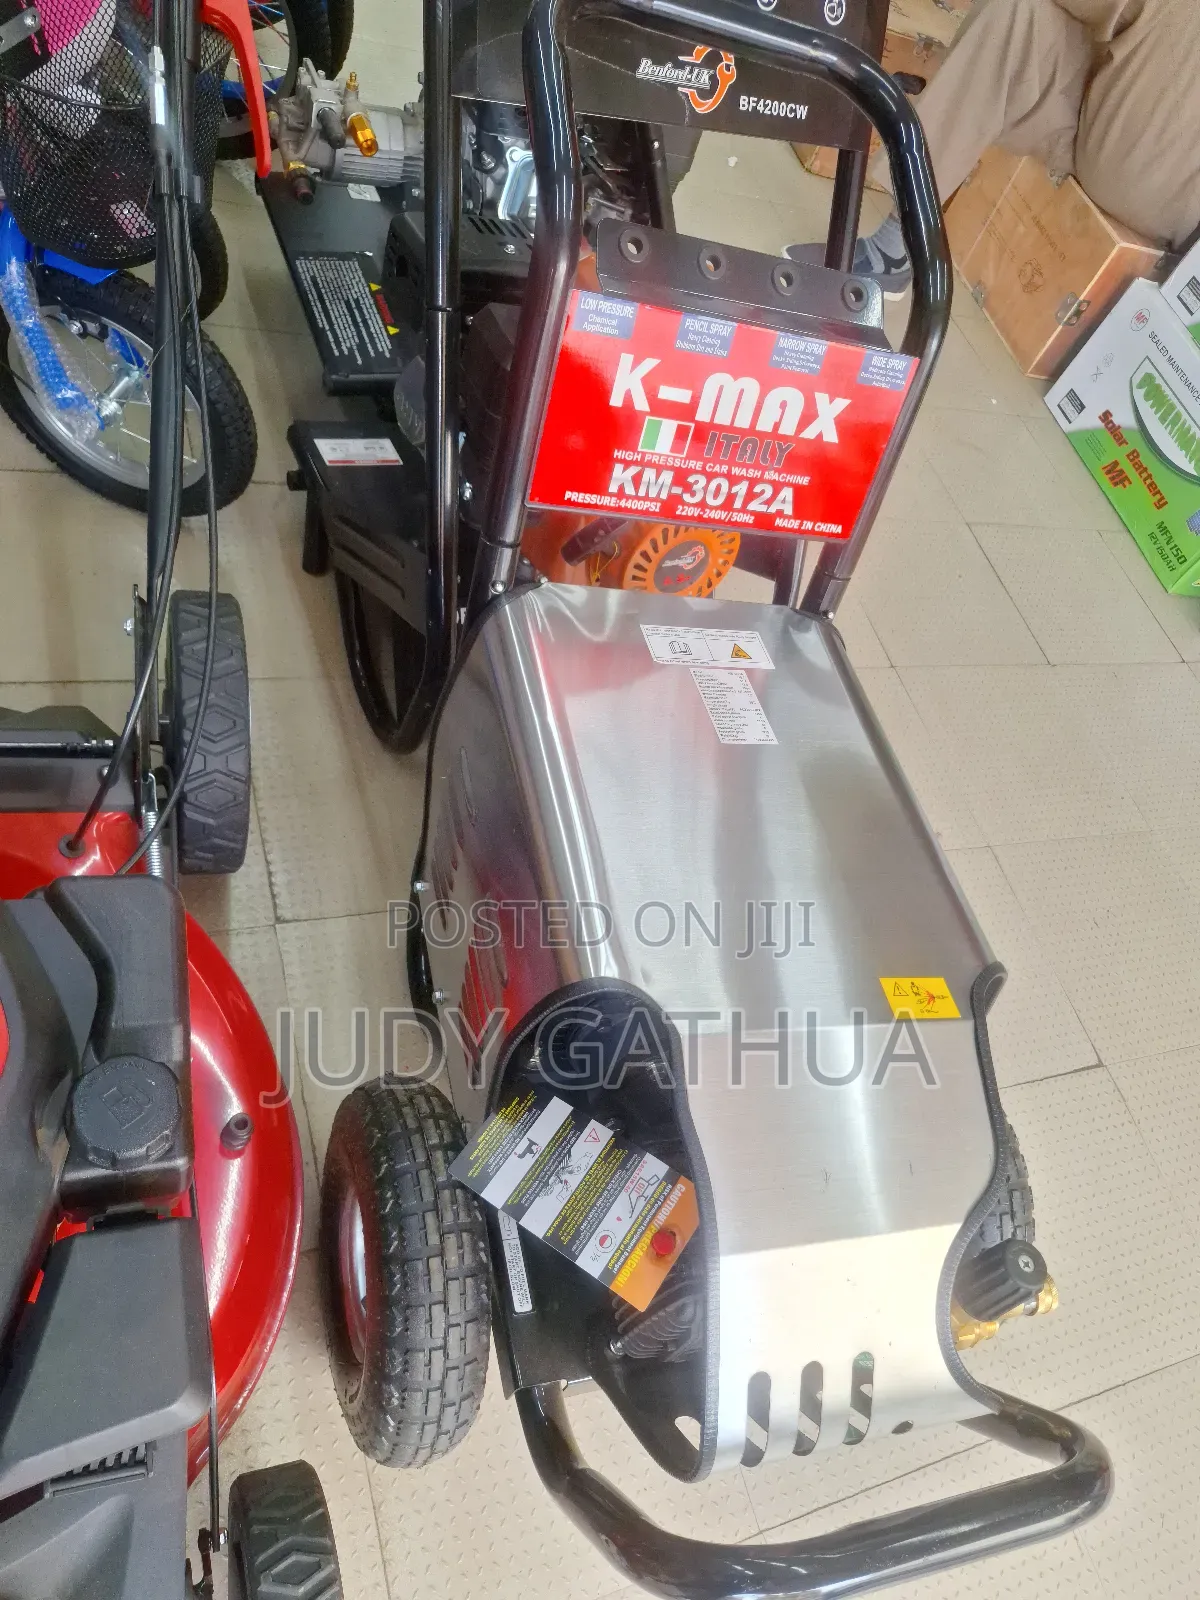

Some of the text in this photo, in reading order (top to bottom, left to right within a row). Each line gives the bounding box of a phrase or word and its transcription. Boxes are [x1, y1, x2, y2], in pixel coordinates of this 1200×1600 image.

[739, 95, 808, 119] BF4200CW
[580, 296, 634, 318] LOW PRESSURE
[1133, 311, 1148, 326] MF
[583, 321, 619, 335] Application
[684, 318, 732, 337] PENCIL SPRAY
[778, 337, 827, 356] NARROW SPRAY
[871, 355, 907, 371] WIDE SPRAY
[1147, 330, 1200, 402] SEALED MAINTENANCE
[704, 431, 795, 468] ITALY
[1097, 408, 1169, 511] Solar Battery
[613, 449, 811, 486] HIGH PRESSURE CAR WASH MACHINE
[1101, 458, 1133, 492] MF
[608, 463, 795, 516] KM-3012A
[564, 490, 843, 534] PRESSURE:4400PSI 220V-240V/50Hz MADE IN CHINA
[661, 1182, 672, 1196] RISK
[641, 1199, 662, 1227] Permanent
[624, 1224, 646, 1252] Equipment
